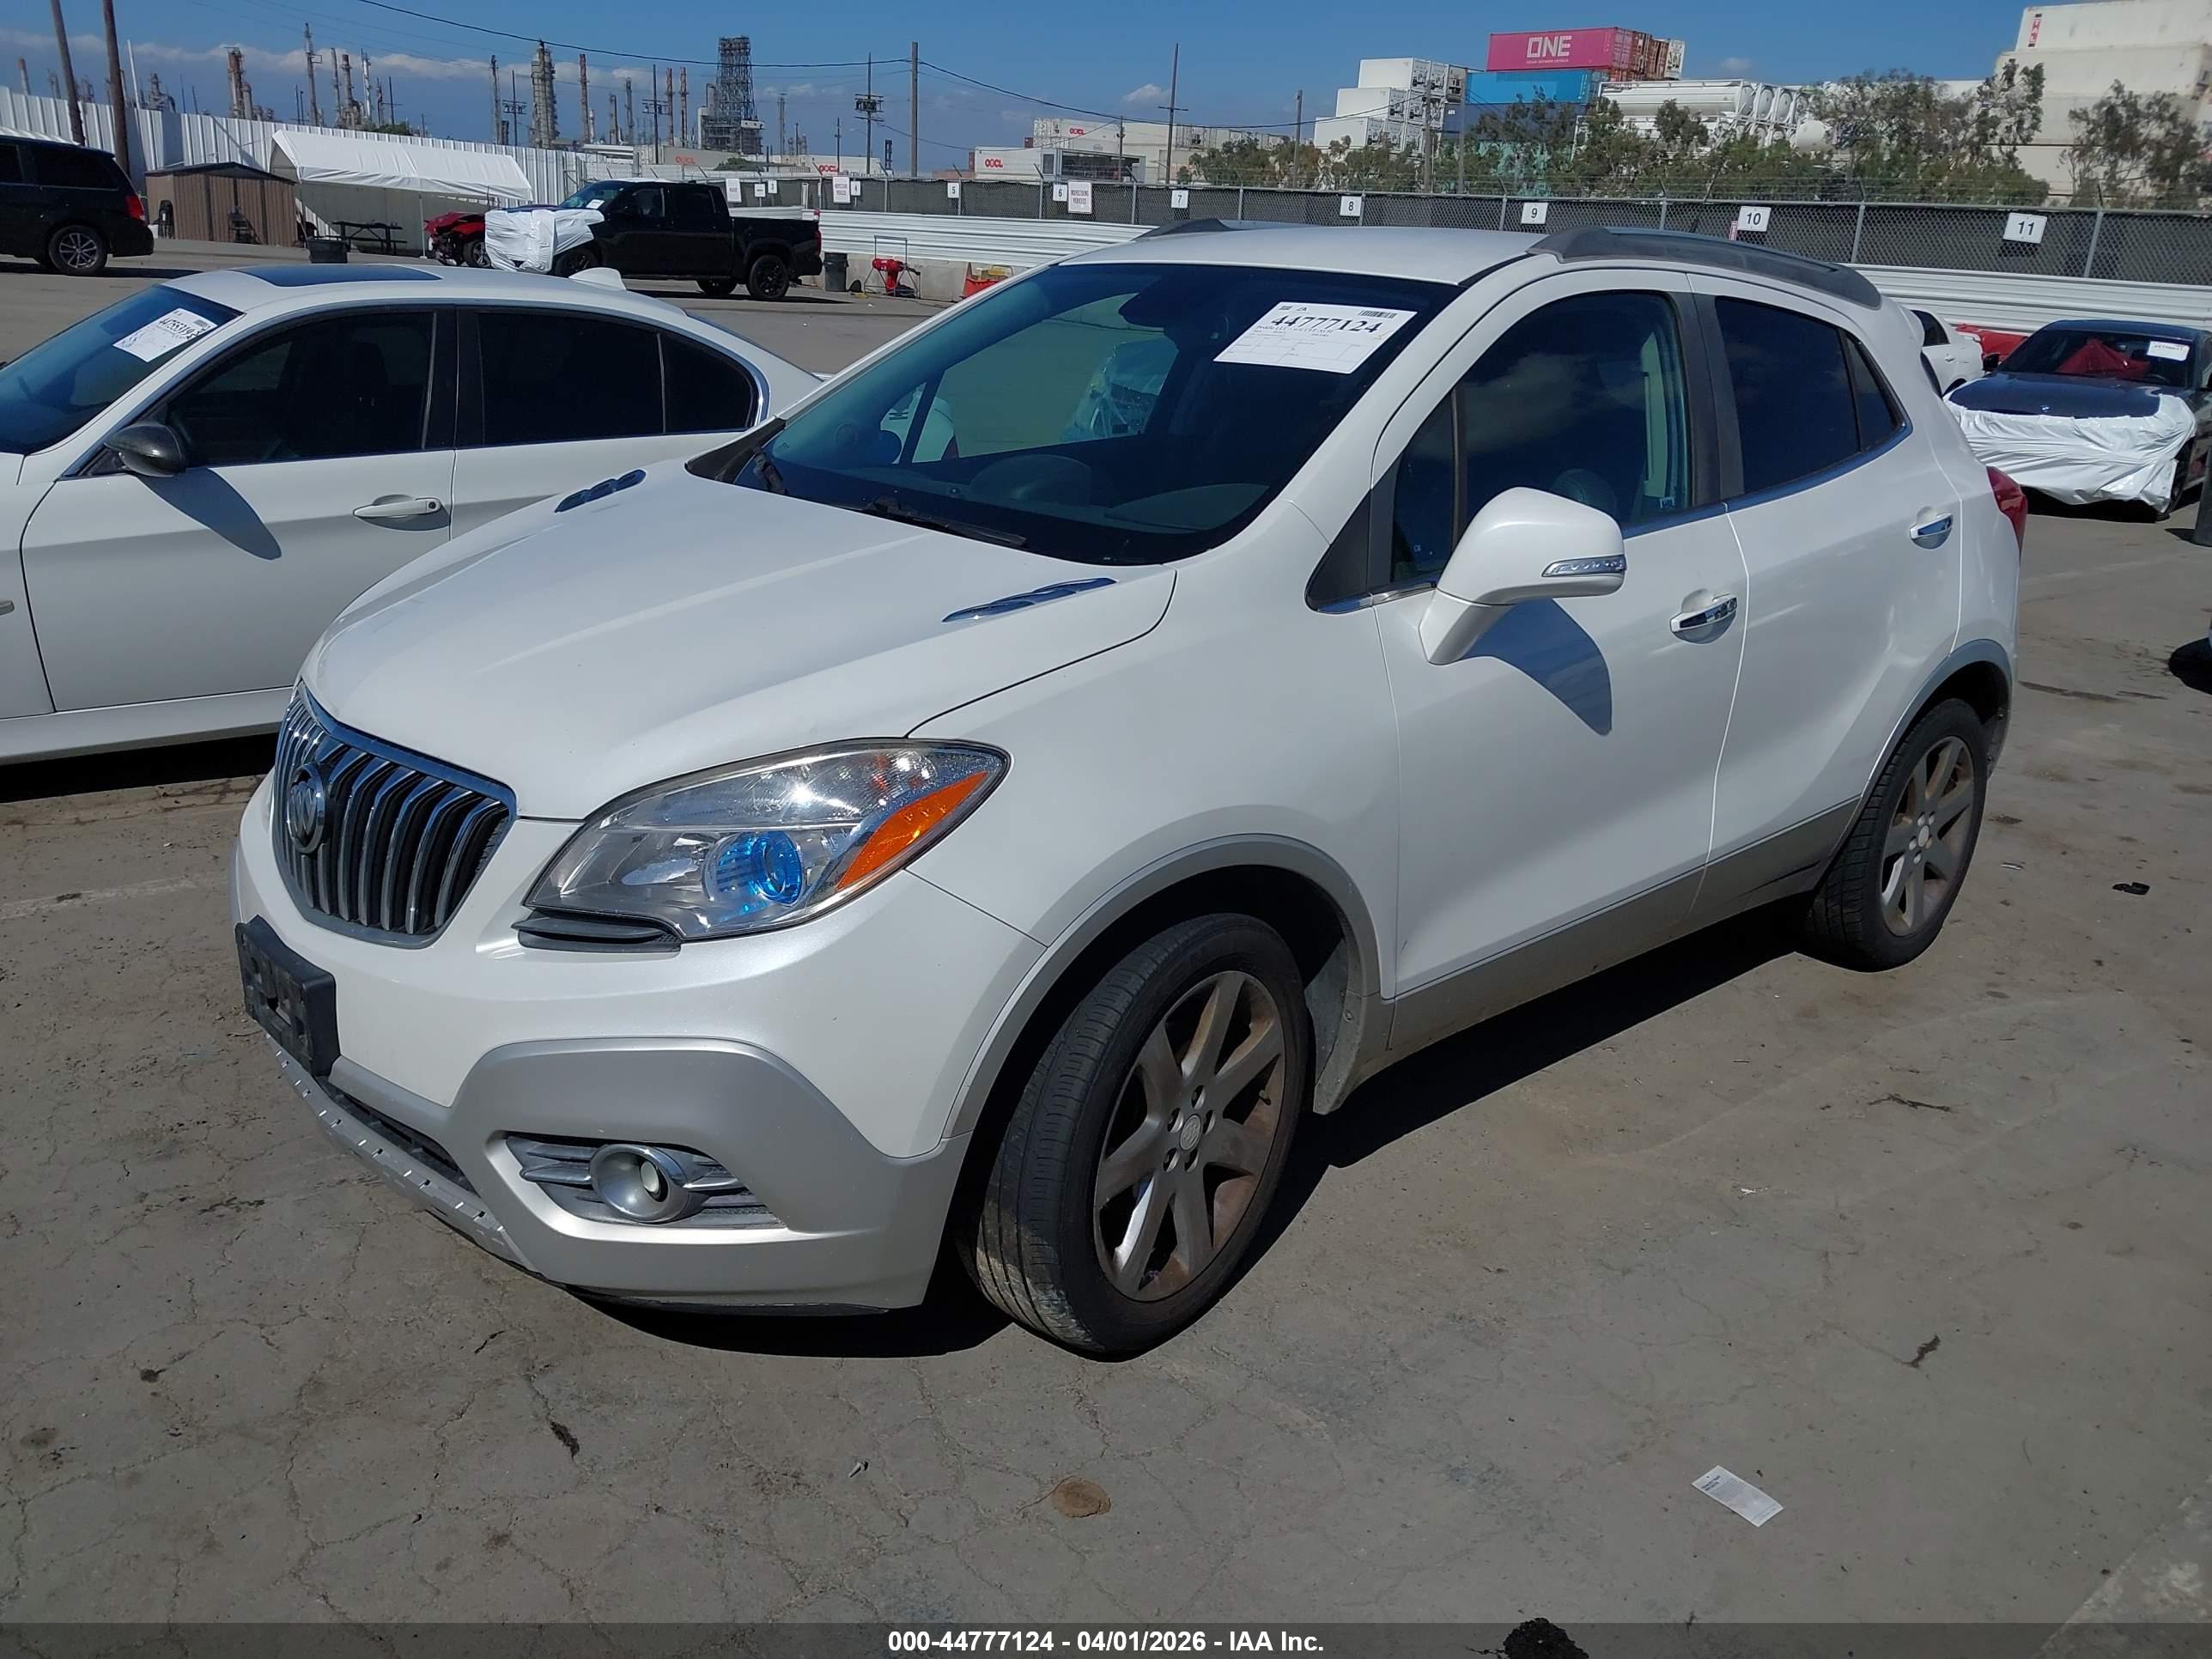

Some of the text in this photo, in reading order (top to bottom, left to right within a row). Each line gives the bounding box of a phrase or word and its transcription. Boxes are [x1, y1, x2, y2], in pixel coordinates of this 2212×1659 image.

[1527, 35, 1572, 58] ONE
[985, 158, 1003, 167] OOCL
[951, 185, 956, 194] 5
[1058, 188, 1063, 198] 6
[1177, 194, 1182, 204] 7
[1348, 201, 1354, 211] 8
[1531, 207, 1538, 219] 9
[1747, 212, 1761, 225] 10
[2018, 221, 2035, 235] 11
[1271, 315, 1383, 333] 44777124
